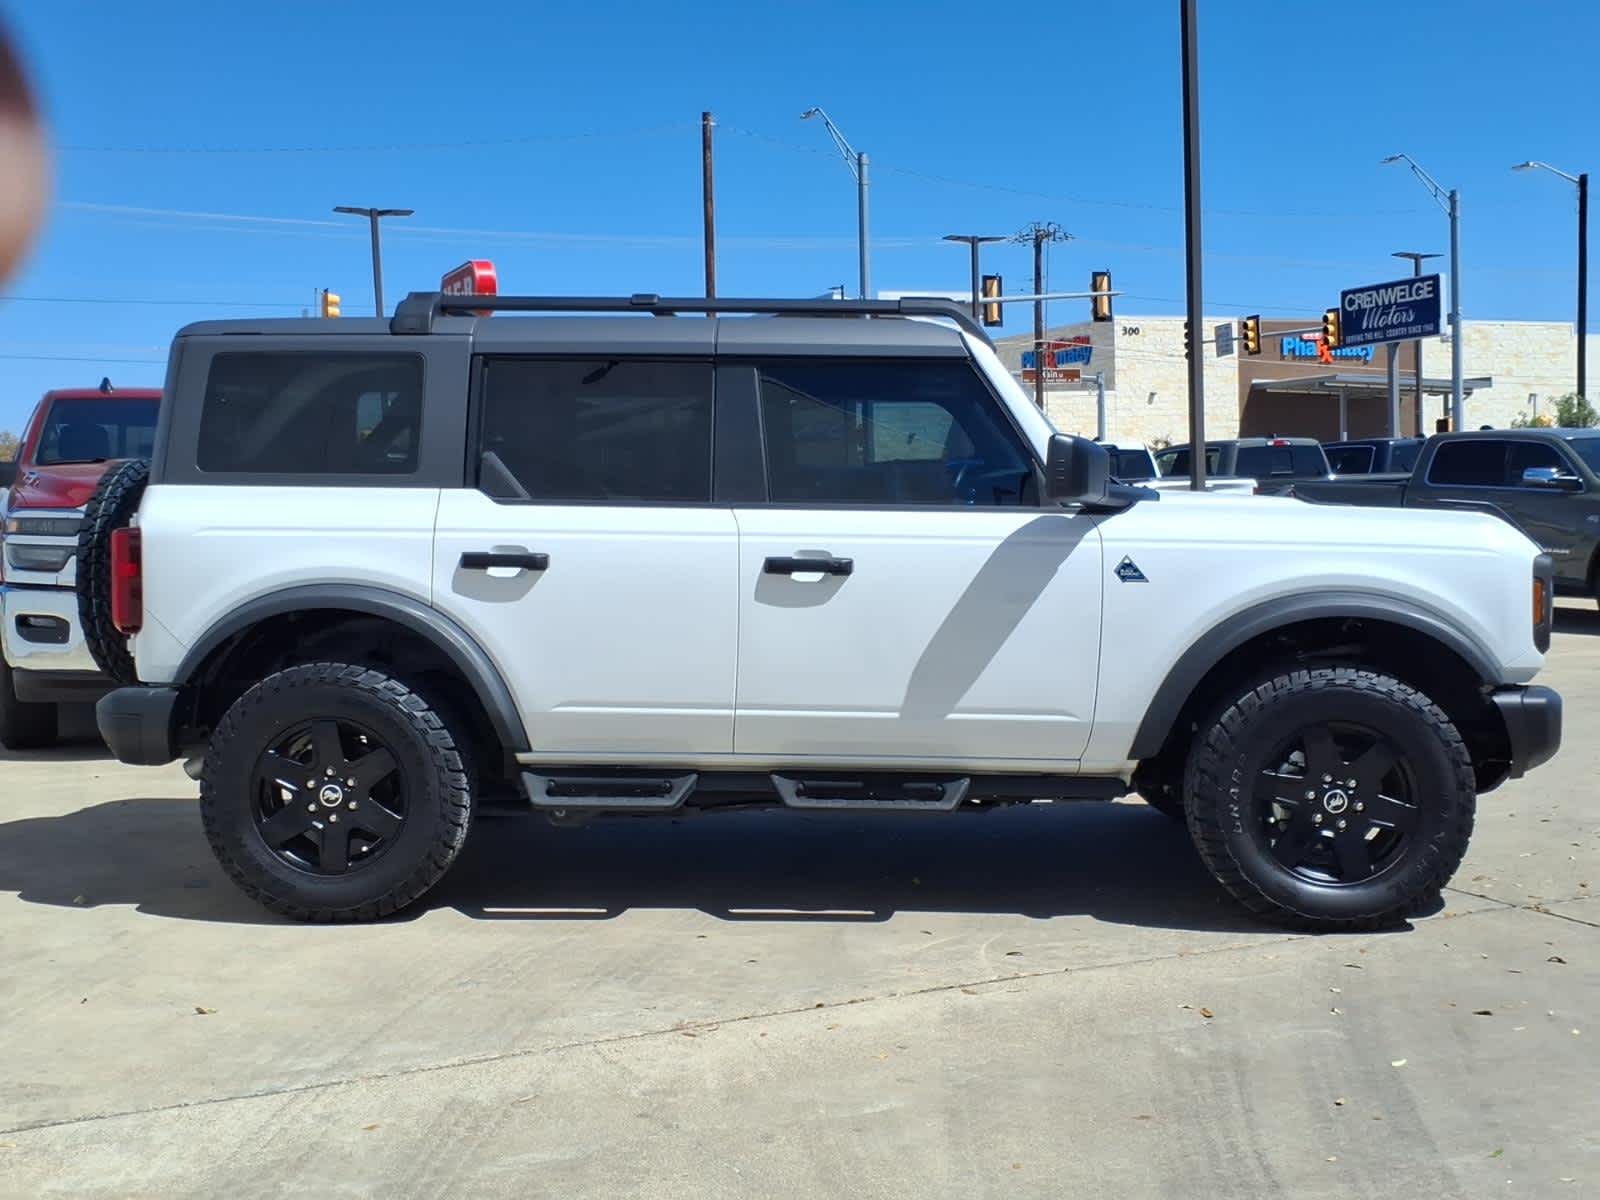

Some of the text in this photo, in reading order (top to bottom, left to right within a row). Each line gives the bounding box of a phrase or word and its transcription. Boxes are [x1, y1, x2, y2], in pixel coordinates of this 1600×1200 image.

[1344, 281, 1434, 311] CRENWELGE
[1361, 304, 1416, 330] Motors
[1122, 326, 1140, 336] 300
